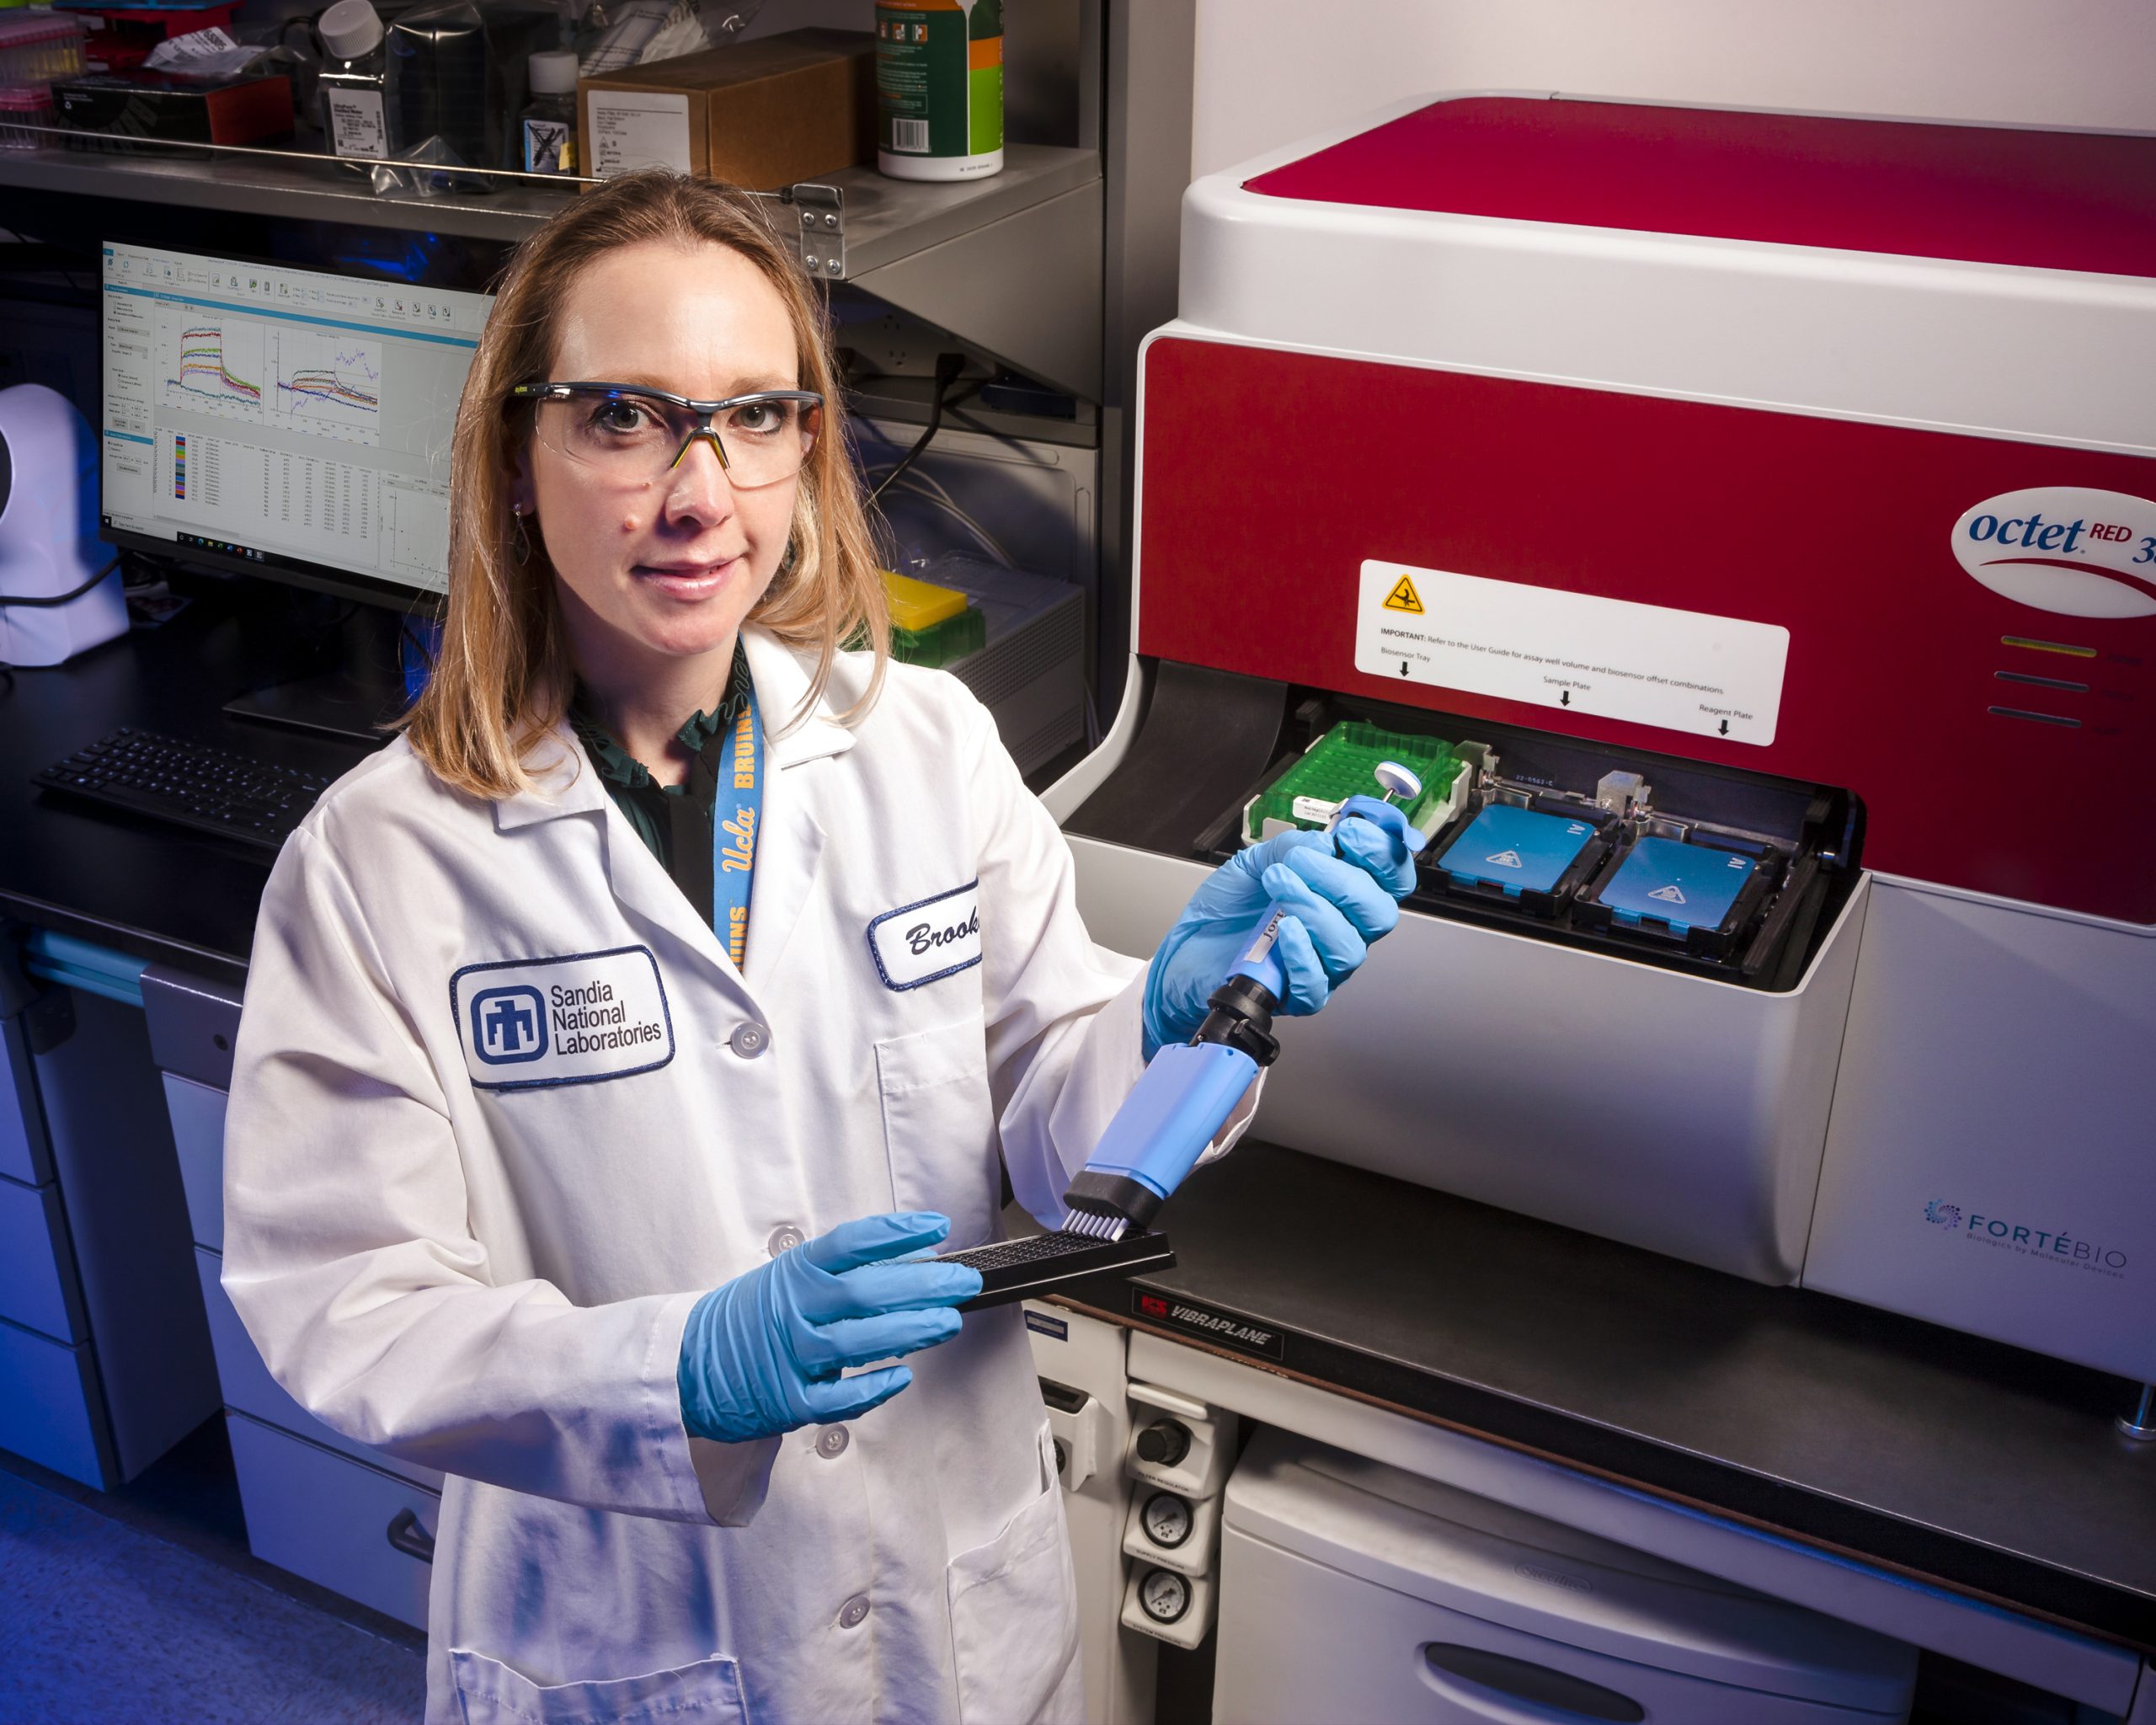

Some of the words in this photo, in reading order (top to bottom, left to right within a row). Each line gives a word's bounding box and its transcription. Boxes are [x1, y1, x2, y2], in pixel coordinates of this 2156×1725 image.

[2089, 523, 2132, 542] RED
[2132, 537, 2156, 563] 3
[1380, 628, 1427, 642] IMPORTANT:
[1428, 635, 1446, 646] Refer
[1448, 639, 1455, 648] to
[1457, 640, 1469, 649] the
[1471, 644, 1486, 653] User
[1488, 646, 1510, 657] Guide
[1512, 650, 1522, 659] for
[1524, 654, 1543, 664] assay
[1545, 658, 1561, 666] well
[1561, 660, 1590, 671] volume
[1591, 665, 1606, 674] and
[1608, 667, 1645, 680] biosensor
[1646, 674, 1668, 685] offset
[1670, 678, 1724, 695] combinations
[1381, 647, 1414, 659] Biosensor
[1416, 653, 1431, 663] Tray
[1543, 676, 1572, 687] Sample
[1572, 680, 1592, 691] Plate
[1699, 704, 1732, 718] Reagent
[1733, 709, 1753, 721] Plate
[729, 906, 748, 971] UINS
[905, 905, 979, 955] Brook
[1263, 910, 1287, 942] fort
[551, 980, 613, 1007] Sandia
[552, 1000, 626, 1032] National
[555, 1021, 662, 1055] Laboratories
[1967, 1232, 2012, 1250] Biologics
[2015, 1246, 2027, 1254] by
[2030, 1249, 2079, 1268] Molecular
[2083, 1263, 2125, 1279] Devices
[1969, 1215, 2127, 1268] FORTÉBIO
[1171, 1305, 1273, 1345] VIBRAPLANE
